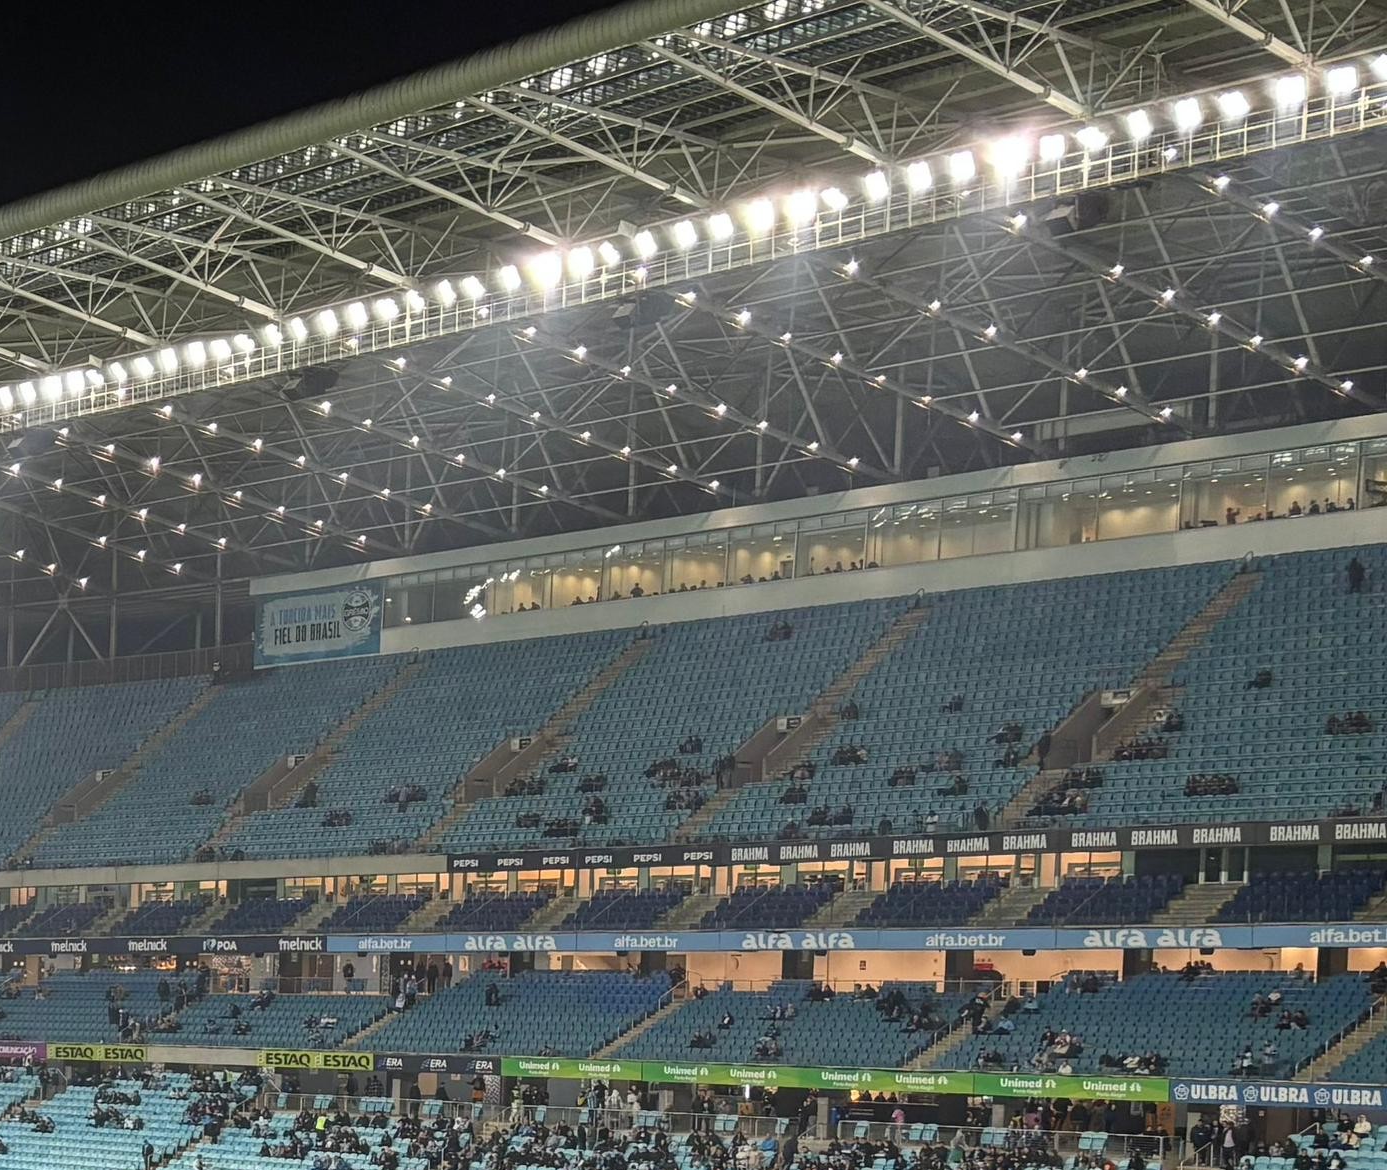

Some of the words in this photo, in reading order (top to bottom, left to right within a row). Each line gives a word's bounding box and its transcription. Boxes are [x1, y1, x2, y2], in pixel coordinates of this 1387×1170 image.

[274, 628, 293, 645] FIEL
[295, 626, 308, 643] DO
[310, 620, 341, 640] BRASIL
[1192, 826, 1242, 844] BRAHMA
[1335, 822, 1387, 840] BRAHMA
[946, 836, 990, 853] BRAHMA
[1071, 831, 1117, 848] BRAHMA
[731, 846, 769, 862] BRAHMA
[830, 842, 871, 858] BRAHMA
[453, 859, 479, 868] PEPSI
[542, 855, 570, 866] PEPSI
[633, 853, 662, 863] PEPSI
[278, 936, 323, 951] melnick
[464, 935, 508, 951] alfa
[512, 935, 557, 951] alfa
[742, 931, 795, 950] alfa
[801, 932, 855, 950] alfa
[925, 933, 1006, 947] alfa.bet.br
[1083, 928, 1149, 948] alfa
[1156, 928, 1223, 948] alfa
[1309, 928, 1387, 944] alfa.bet.
[127, 938, 168, 952] melnick
[357, 936, 413, 952] alfa.bet.br
[55, 1046, 94, 1060] ESTAQ
[104, 1047, 144, 1061] ESTAQ
[265, 1052, 311, 1067] ESTAQ
[322, 1054, 370, 1069] ESTAQ
[386, 1057, 403, 1068] ERA
[476, 1060, 493, 1071] ERA
[578, 1063, 610, 1073] Unimed
[664, 1066, 698, 1077] Unimed
[821, 1071, 859, 1082] Unimed
[1000, 1077, 1043, 1089] Unimed
[1082, 1080, 1127, 1092] Unimed
[1191, 1084, 1238, 1100] ULBRA
[1260, 1086, 1309, 1103] ULBRA
[1331, 1088, 1382, 1106] ULBRA
